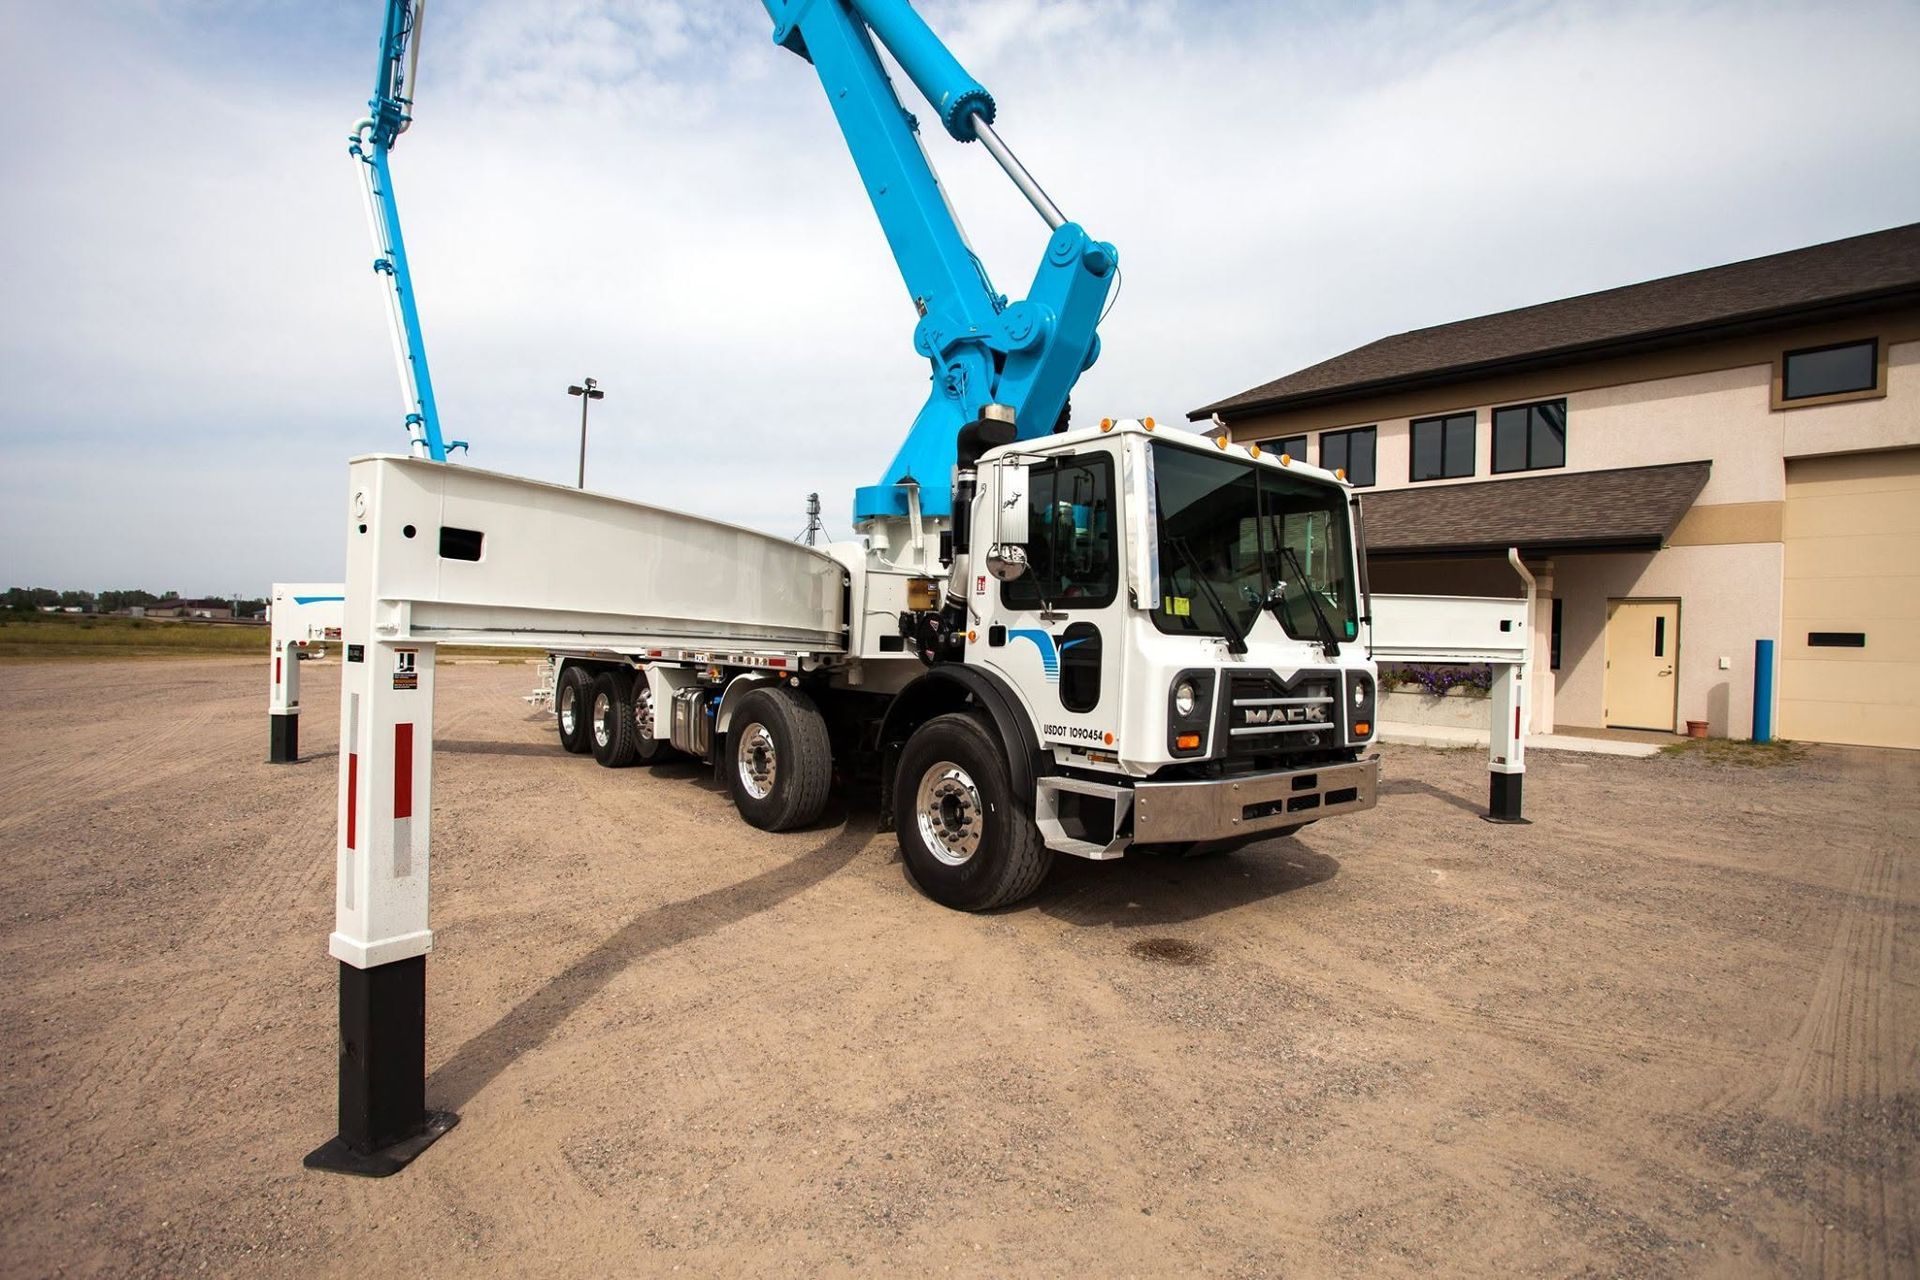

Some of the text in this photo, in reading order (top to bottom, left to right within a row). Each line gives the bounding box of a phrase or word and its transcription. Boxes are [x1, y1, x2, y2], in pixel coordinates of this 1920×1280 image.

[1245, 706, 1325, 723] MACK
[1043, 724, 1103, 740] USDOT 1090454
